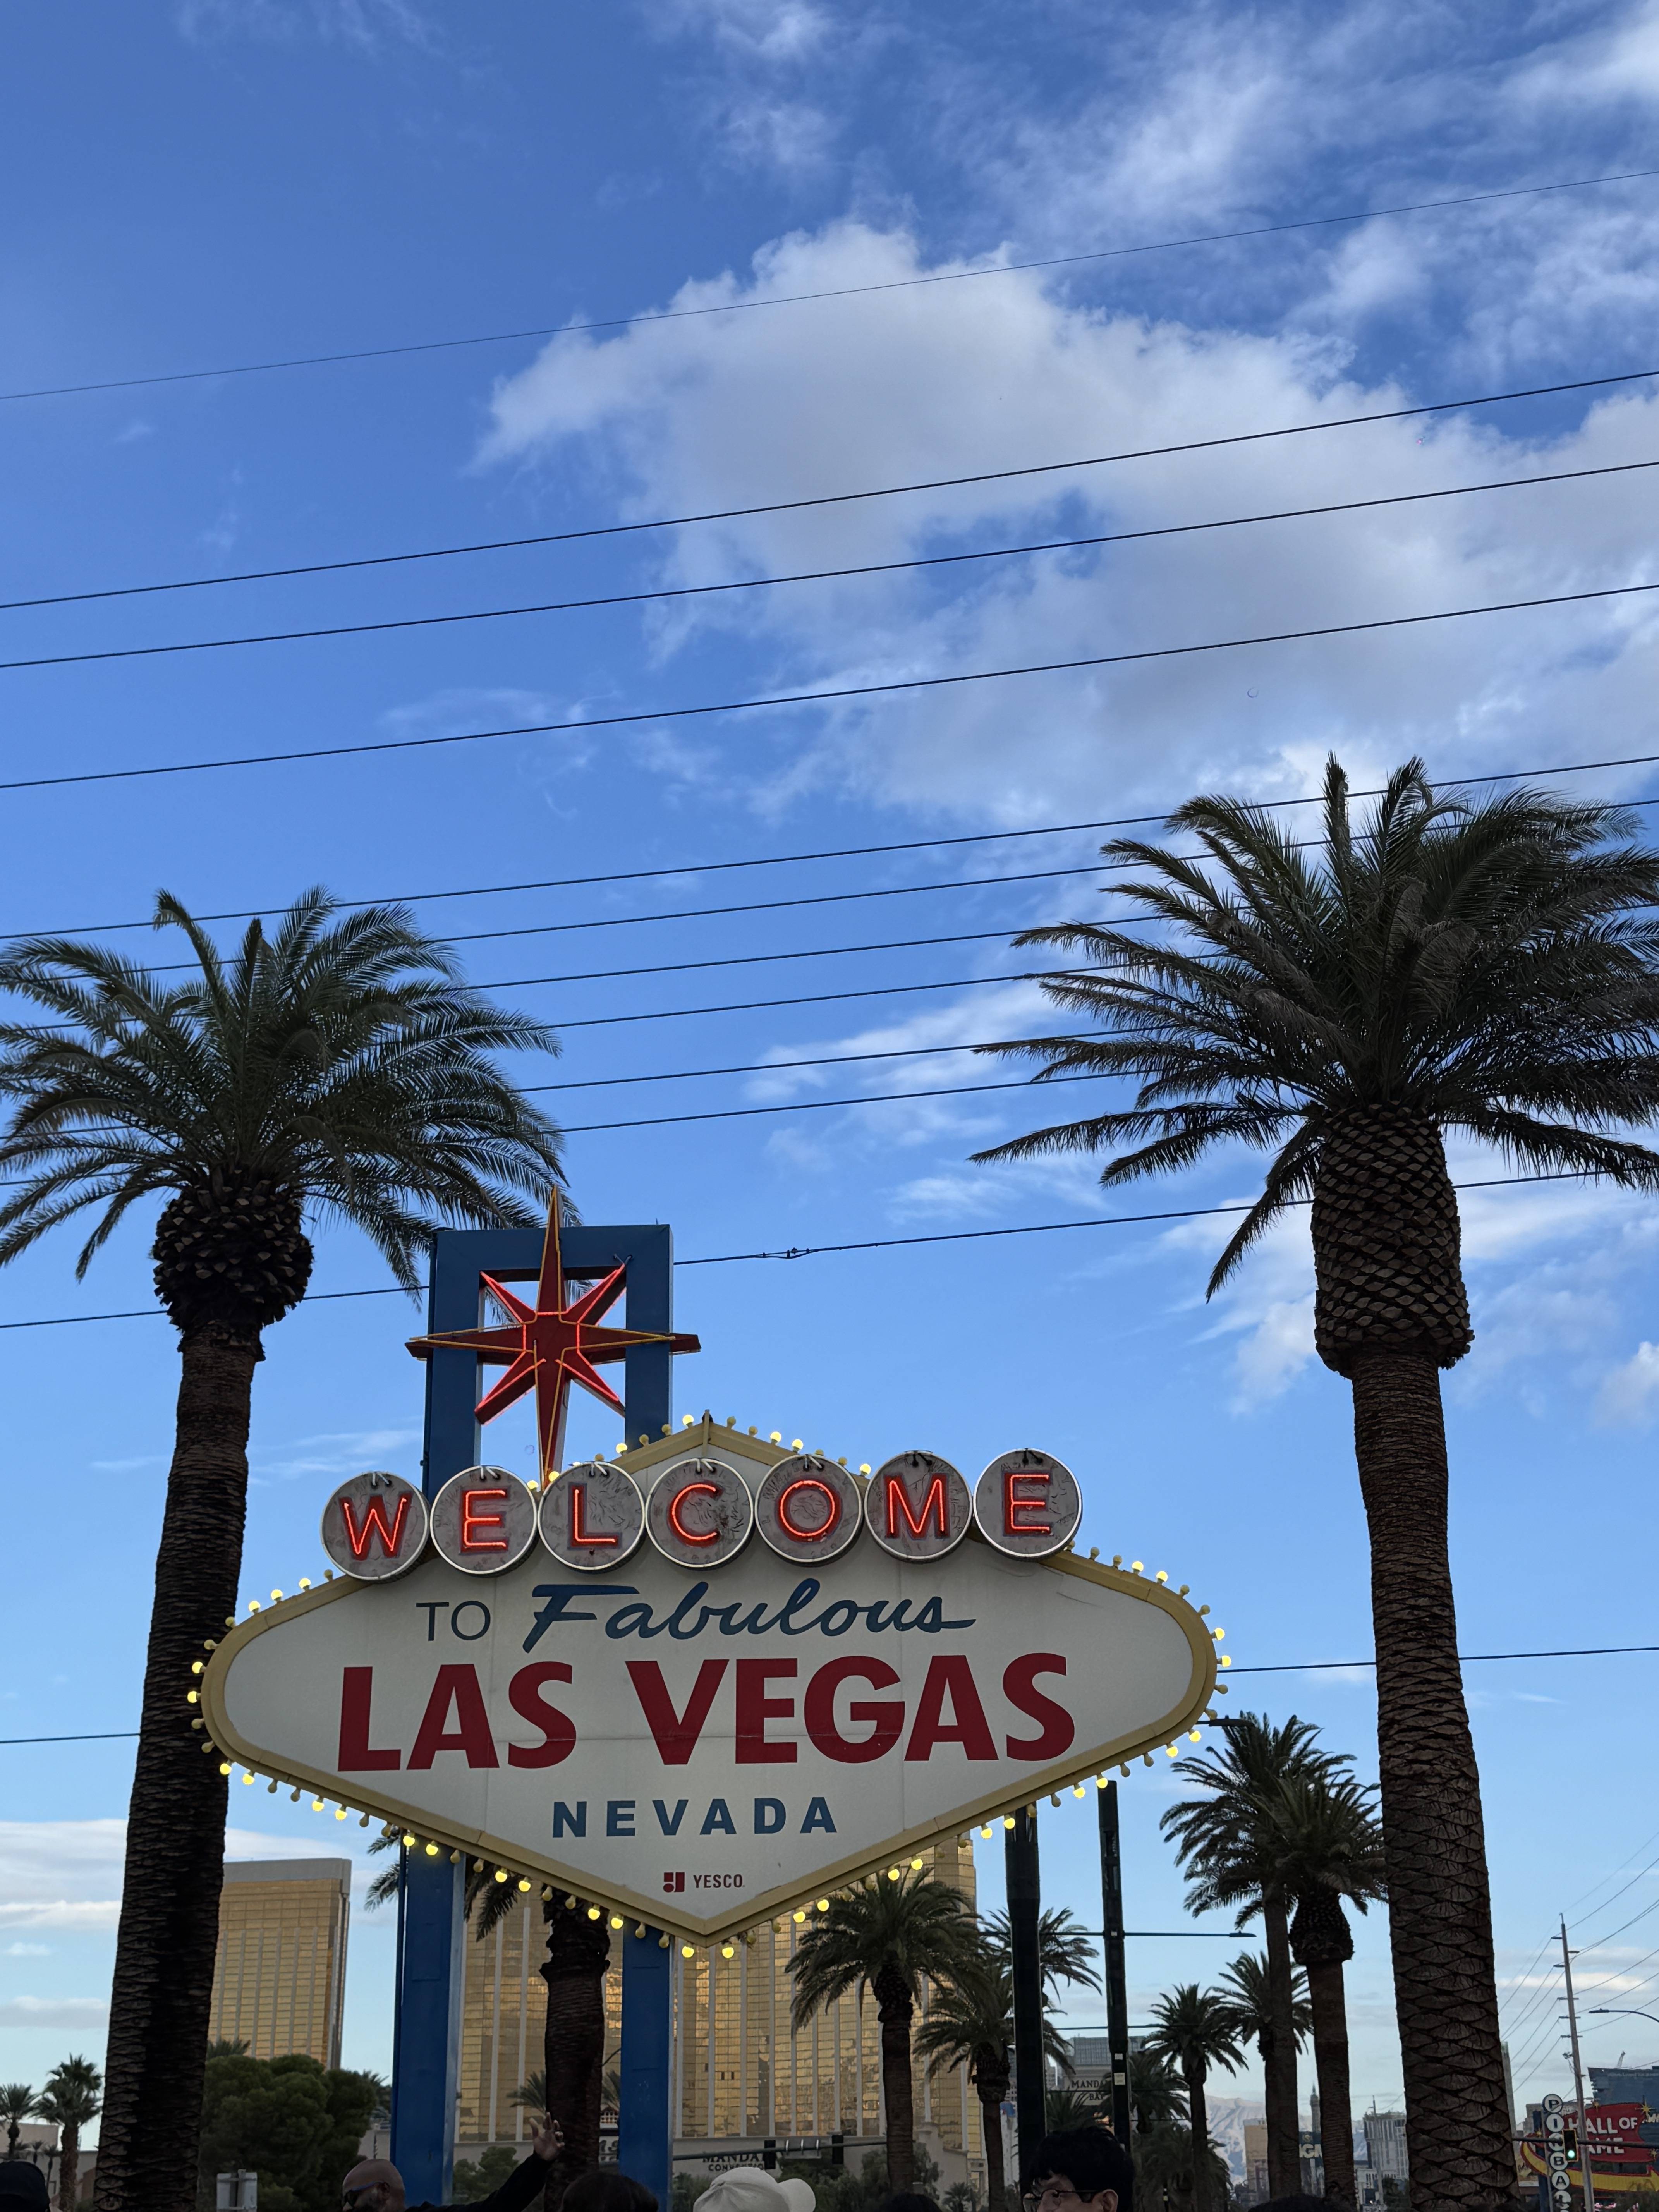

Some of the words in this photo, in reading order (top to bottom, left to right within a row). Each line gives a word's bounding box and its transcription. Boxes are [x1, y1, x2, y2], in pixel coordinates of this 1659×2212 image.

[340, 1472, 1052, 1561] WELCOME
[416, 1600, 491, 1642] TO
[523, 1578, 976, 1654] Fabulous
[338, 1661, 577, 1772] LAS
[625, 1652, 1075, 1765] VEGAS
[553, 1796, 837, 1838] NEVADA
[693, 1874, 743, 1889] YESCO
[1568, 2117, 1618, 2134] HALL
[1619, 2117, 1638, 2130] OF
